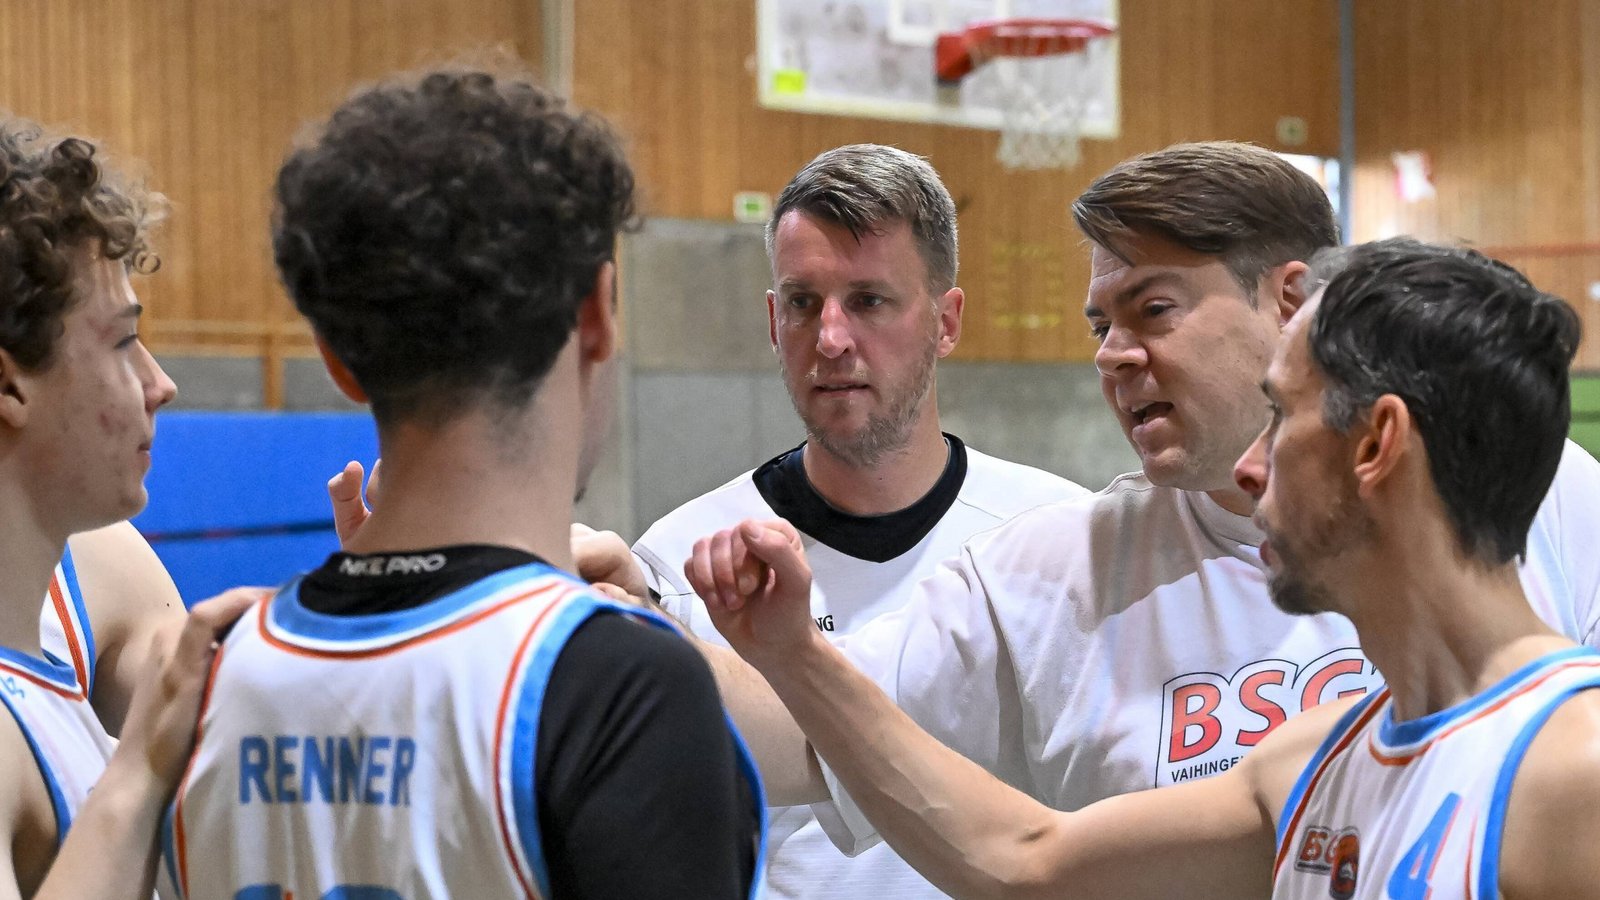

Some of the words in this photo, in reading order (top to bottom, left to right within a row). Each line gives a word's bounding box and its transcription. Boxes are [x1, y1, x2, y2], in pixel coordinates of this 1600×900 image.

[1168, 659, 1365, 763] BSG
[239, 735, 417, 807] RENNER
[1171, 755, 1244, 783] VAIHINGE
[1387, 791, 1463, 900] 4
